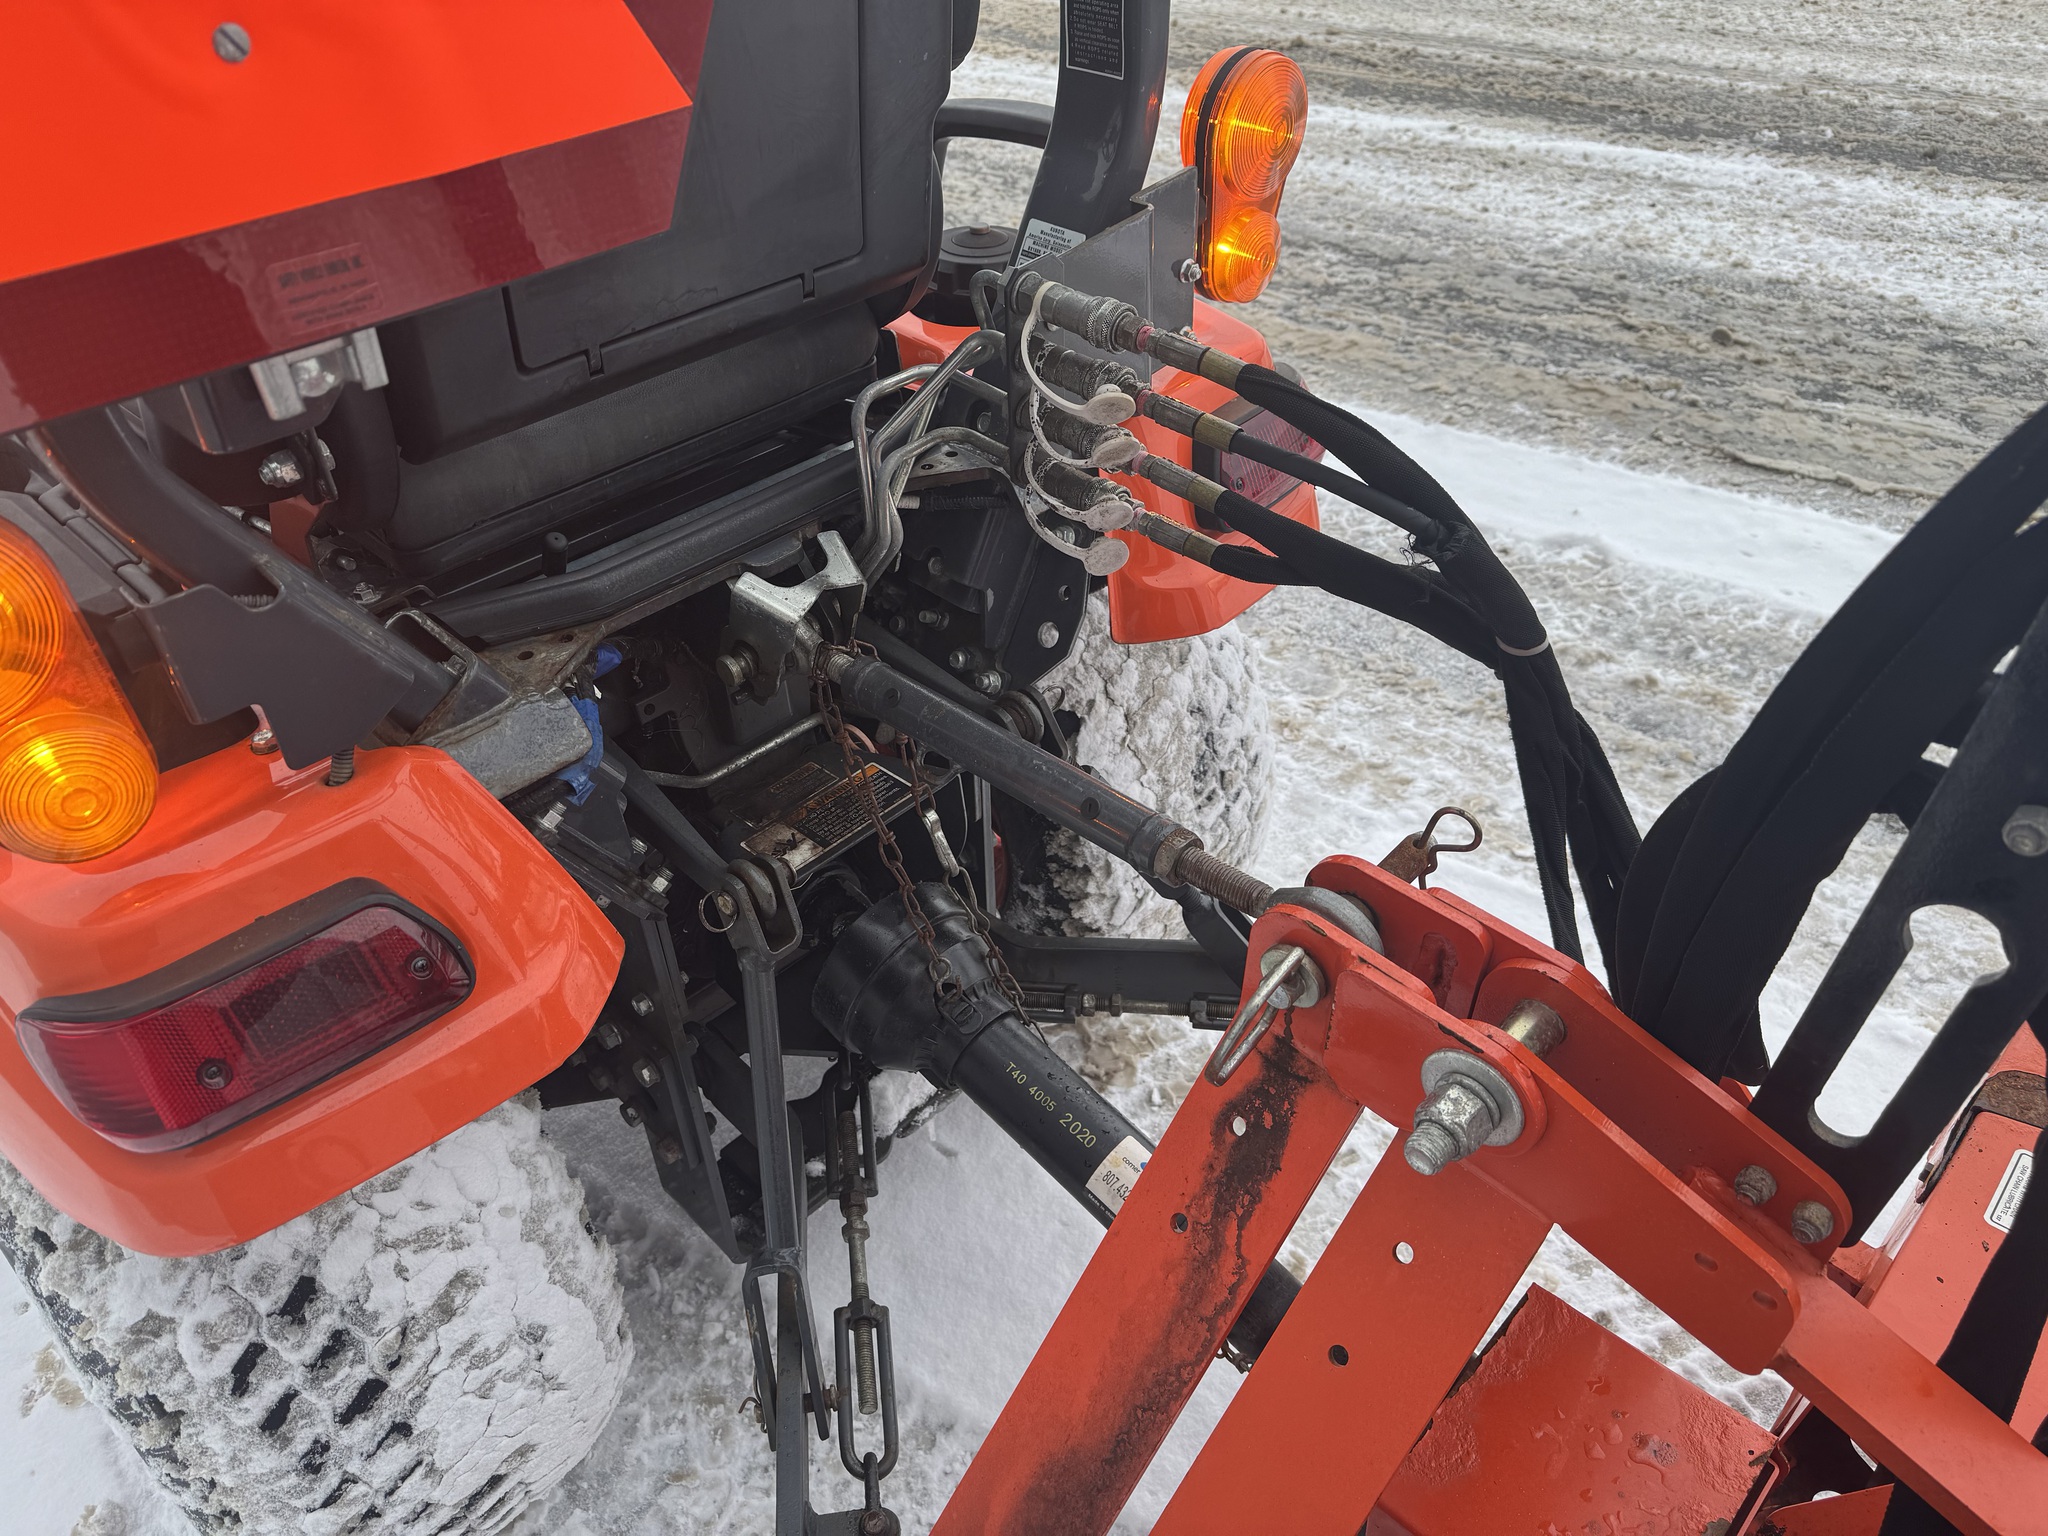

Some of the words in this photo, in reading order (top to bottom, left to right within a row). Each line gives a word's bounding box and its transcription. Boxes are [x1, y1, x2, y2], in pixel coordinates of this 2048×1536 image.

[1040, 230, 1066, 243] Manufacturing
[1050, 227, 1065, 235] KUBOTA
[1033, 240, 1049, 250] MACHINE
[1005, 1061, 1027, 1085] T40
[1028, 1085, 1057, 1112] 4005
[1059, 1112, 1097, 1148] 2020
[2020, 1164, 2029, 1176] SAW
[2012, 1175, 2024, 1191] CHAIN
[1088, 1193, 1100, 1207] Made
[2001, 1188, 2017, 1216] LUBRICATE
